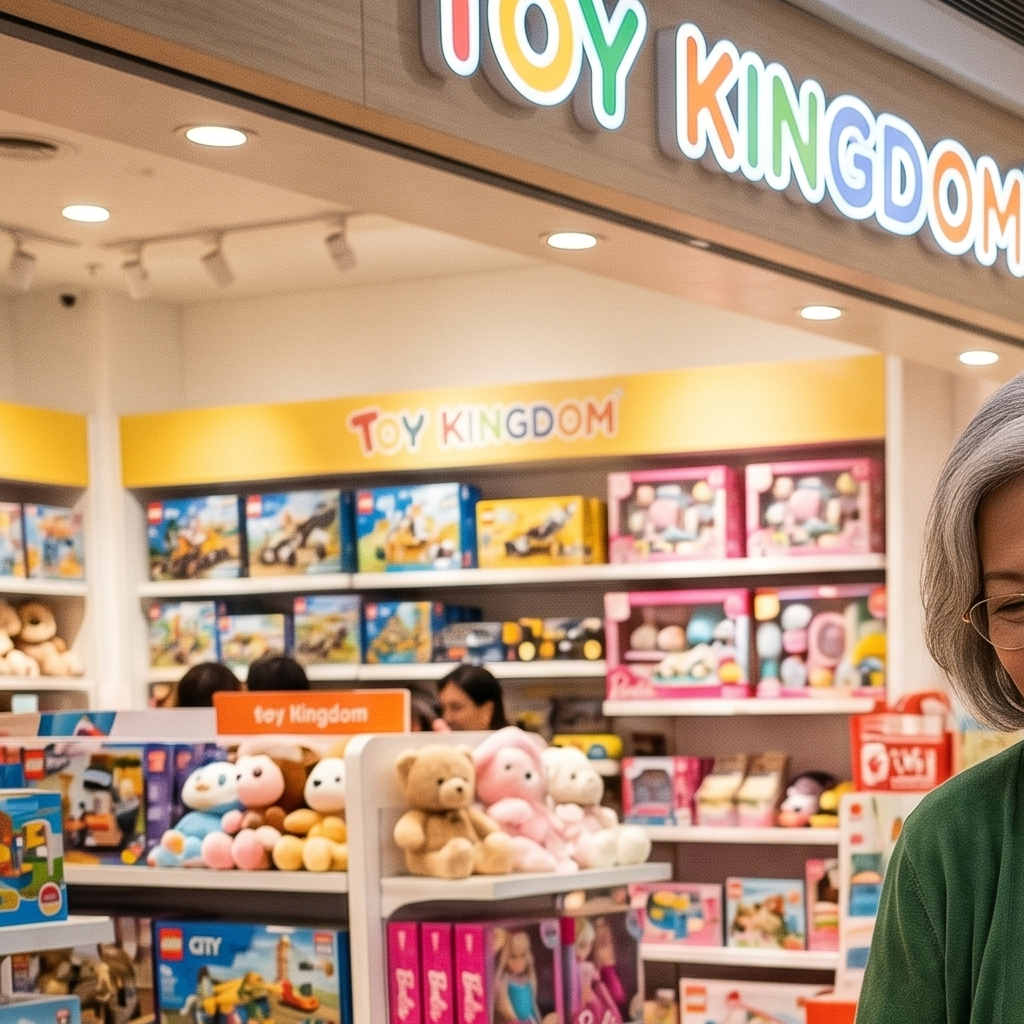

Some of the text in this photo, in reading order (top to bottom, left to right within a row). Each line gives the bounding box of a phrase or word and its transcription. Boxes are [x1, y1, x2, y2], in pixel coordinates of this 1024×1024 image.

[351, 400, 614, 453] TOY KINGDOM
[188, 935, 222, 957] CITY
